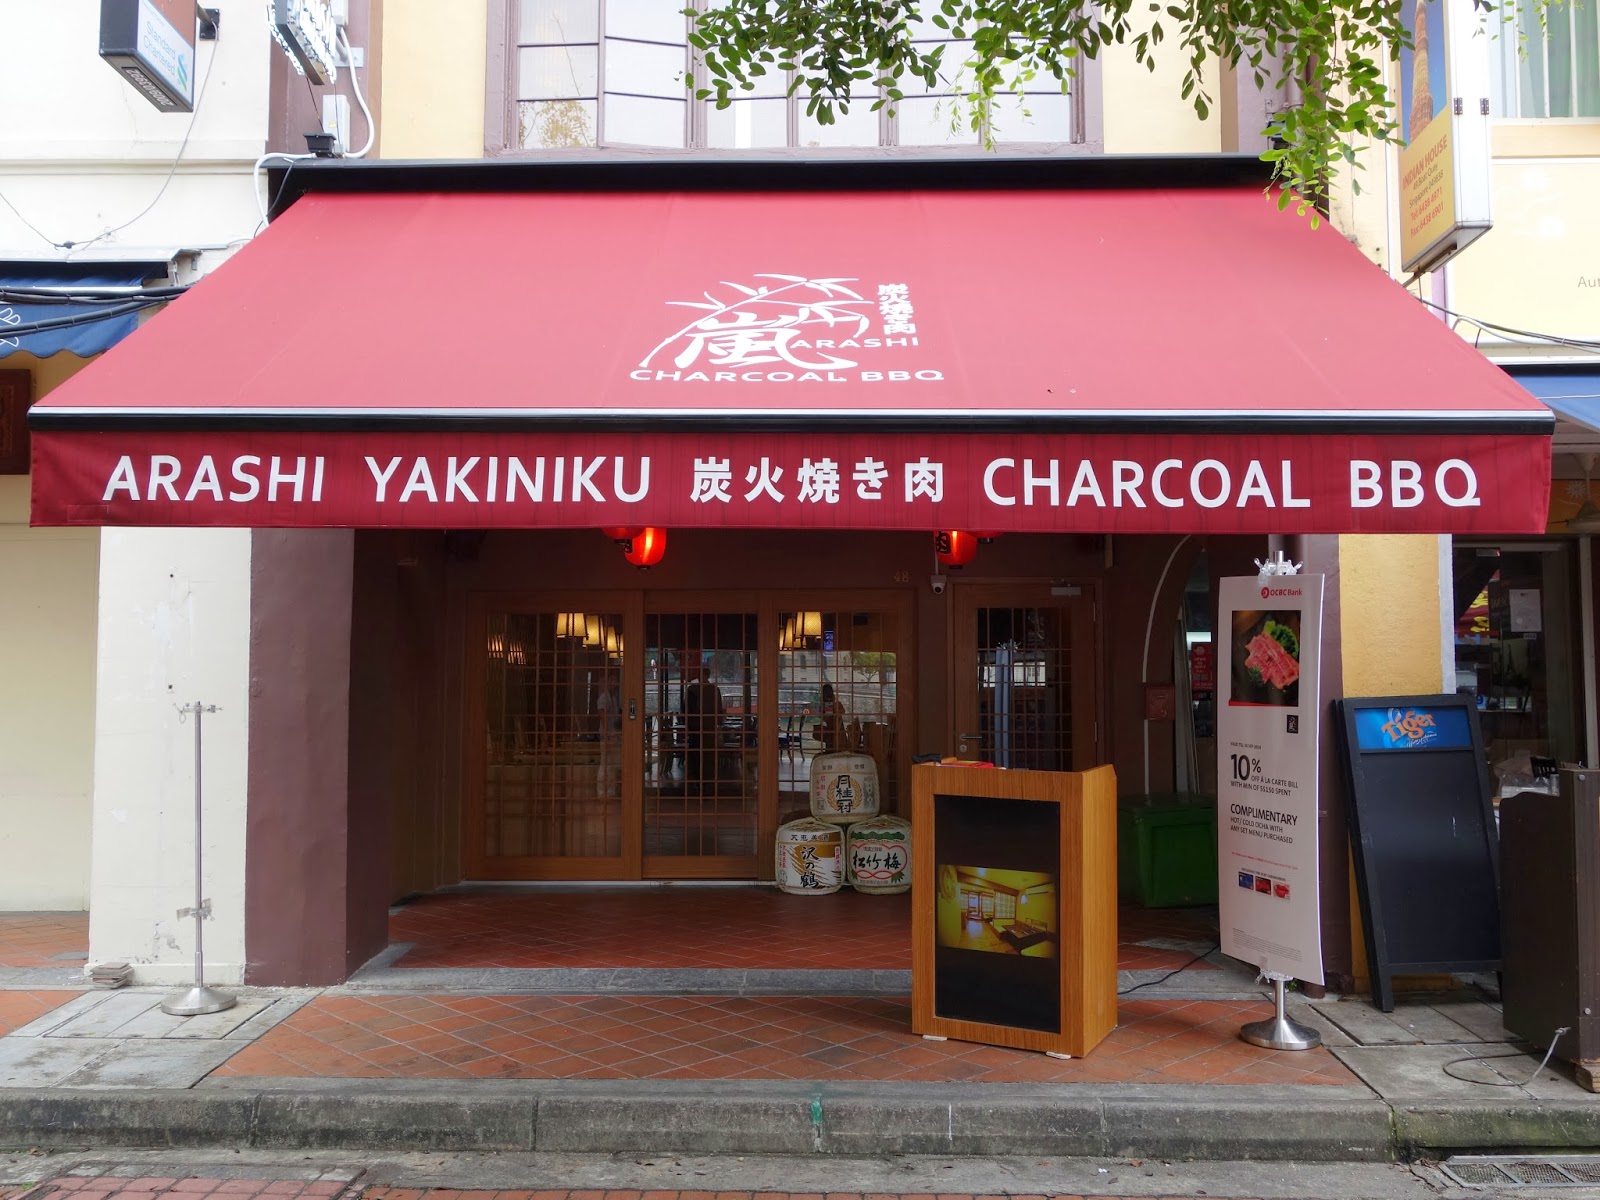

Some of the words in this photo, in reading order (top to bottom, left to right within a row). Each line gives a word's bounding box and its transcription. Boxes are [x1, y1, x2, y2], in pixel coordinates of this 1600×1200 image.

[147, 20, 176, 60] Standard
[143, 34, 175, 75] Chartered
[1403, 157, 1424, 190] INDIAN
[1424, 134, 1448, 168] HOUSE
[877, 283, 917, 335] 炭火焼き肉
[789, 336, 919, 349] ARASHI
[629, 369, 848, 382] CHARCOAL
[860, 369, 945, 382] BBQ
[102, 455, 325, 502] ARASHI
[365, 456, 650, 503] YAKINIKU
[690, 457, 944, 504] 炭火焼き肉
[983, 457, 1311, 508] CHARCOAL
[1350, 458, 1481, 508] BBQ
[1270, 588, 1287, 596] OCBC
[1287, 588, 1303, 596] Bank
[1381, 709, 1437, 743] Tiger
[1230, 753, 1262, 781] 10%
[1230, 780, 1243, 788] WITH
[1243, 782, 1253, 790] MIN
[1275, 788, 1291, 797] SPENT
[1271, 778, 1287, 787] CARTE
[1287, 780, 1299, 789] BILL
[1230, 803, 1298, 826] COMPLIMENTARY
[1242, 818, 1255, 827] COLD
[1255, 820, 1269, 830] OCHA
[1269, 823, 1283, 833] WITH
[1230, 824, 1240, 832] ANY
[1240, 826, 1248, 834] SET
[1248, 828, 1262, 838] MENU
[1263, 831, 1294, 844] PURCHASED
[800, 846, 820, 889] 沢の鶴
[852, 850, 901, 870] 松竹梅
